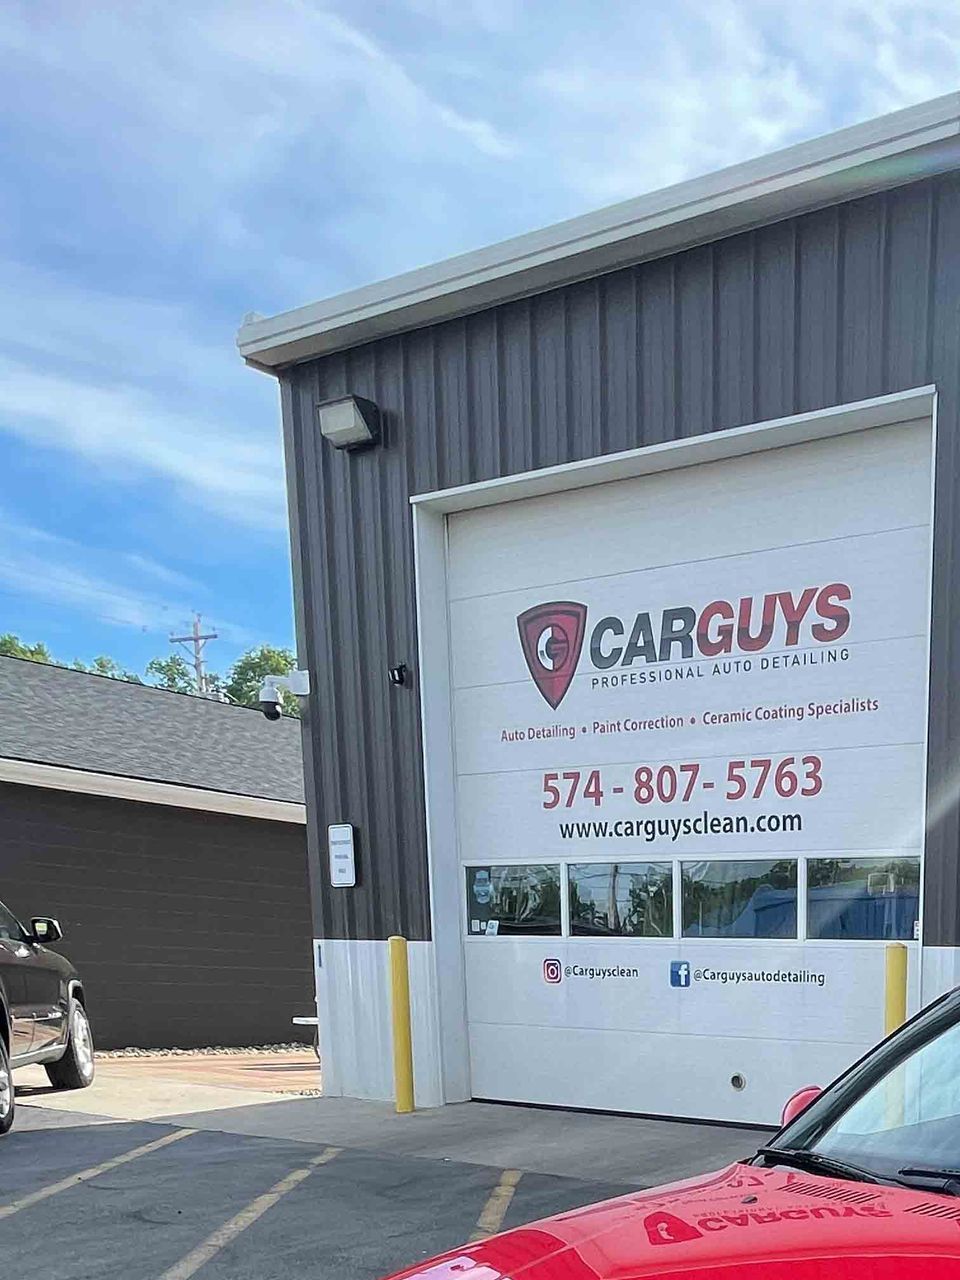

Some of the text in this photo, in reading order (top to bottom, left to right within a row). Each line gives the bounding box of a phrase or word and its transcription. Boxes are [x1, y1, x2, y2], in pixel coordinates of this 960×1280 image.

[590, 583, 852, 670] CARGUYS
[591, 648, 850, 690] PROFESSIONAL AUTO DETAILING
[501, 696, 879, 742] Auto Detailing Paint Correction Ceramic Coating Specialists
[542, 769, 604, 810] 574
[725, 755, 823, 801] 5763
[559, 811, 802, 842] www.carguysclean.com
[564, 963, 639, 981] @Carguysclean
[693, 967, 826, 986] @Carguysautodetailing
